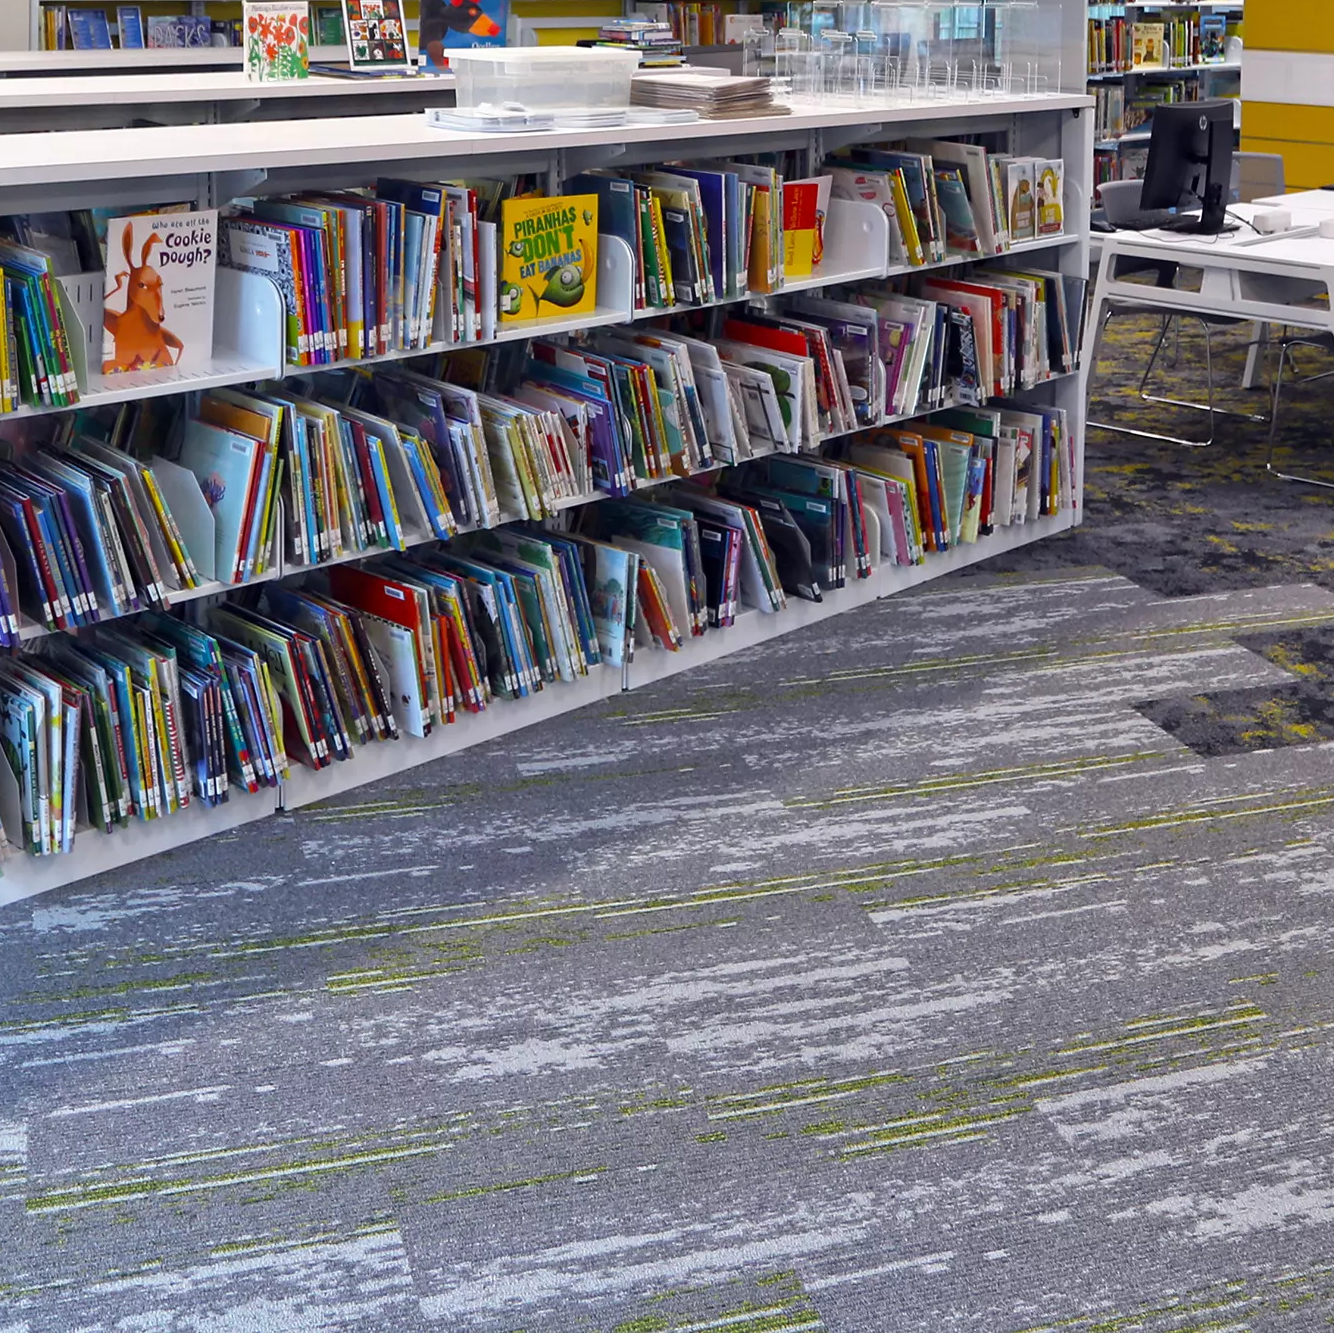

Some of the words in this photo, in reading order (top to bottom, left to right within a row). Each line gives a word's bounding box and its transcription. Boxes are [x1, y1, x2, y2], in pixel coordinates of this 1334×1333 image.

[151, 220, 168, 230] Who
[185, 218, 196, 227] all
[197, 217, 210, 226] the
[514, 206, 577, 239] PIRANHAS
[165, 227, 212, 248] Cookie
[522, 225, 575, 263] DON'T
[159, 248, 212, 268] Dough?
[519, 265, 535, 280] EAT
[538, 250, 582, 274] BANANAS
